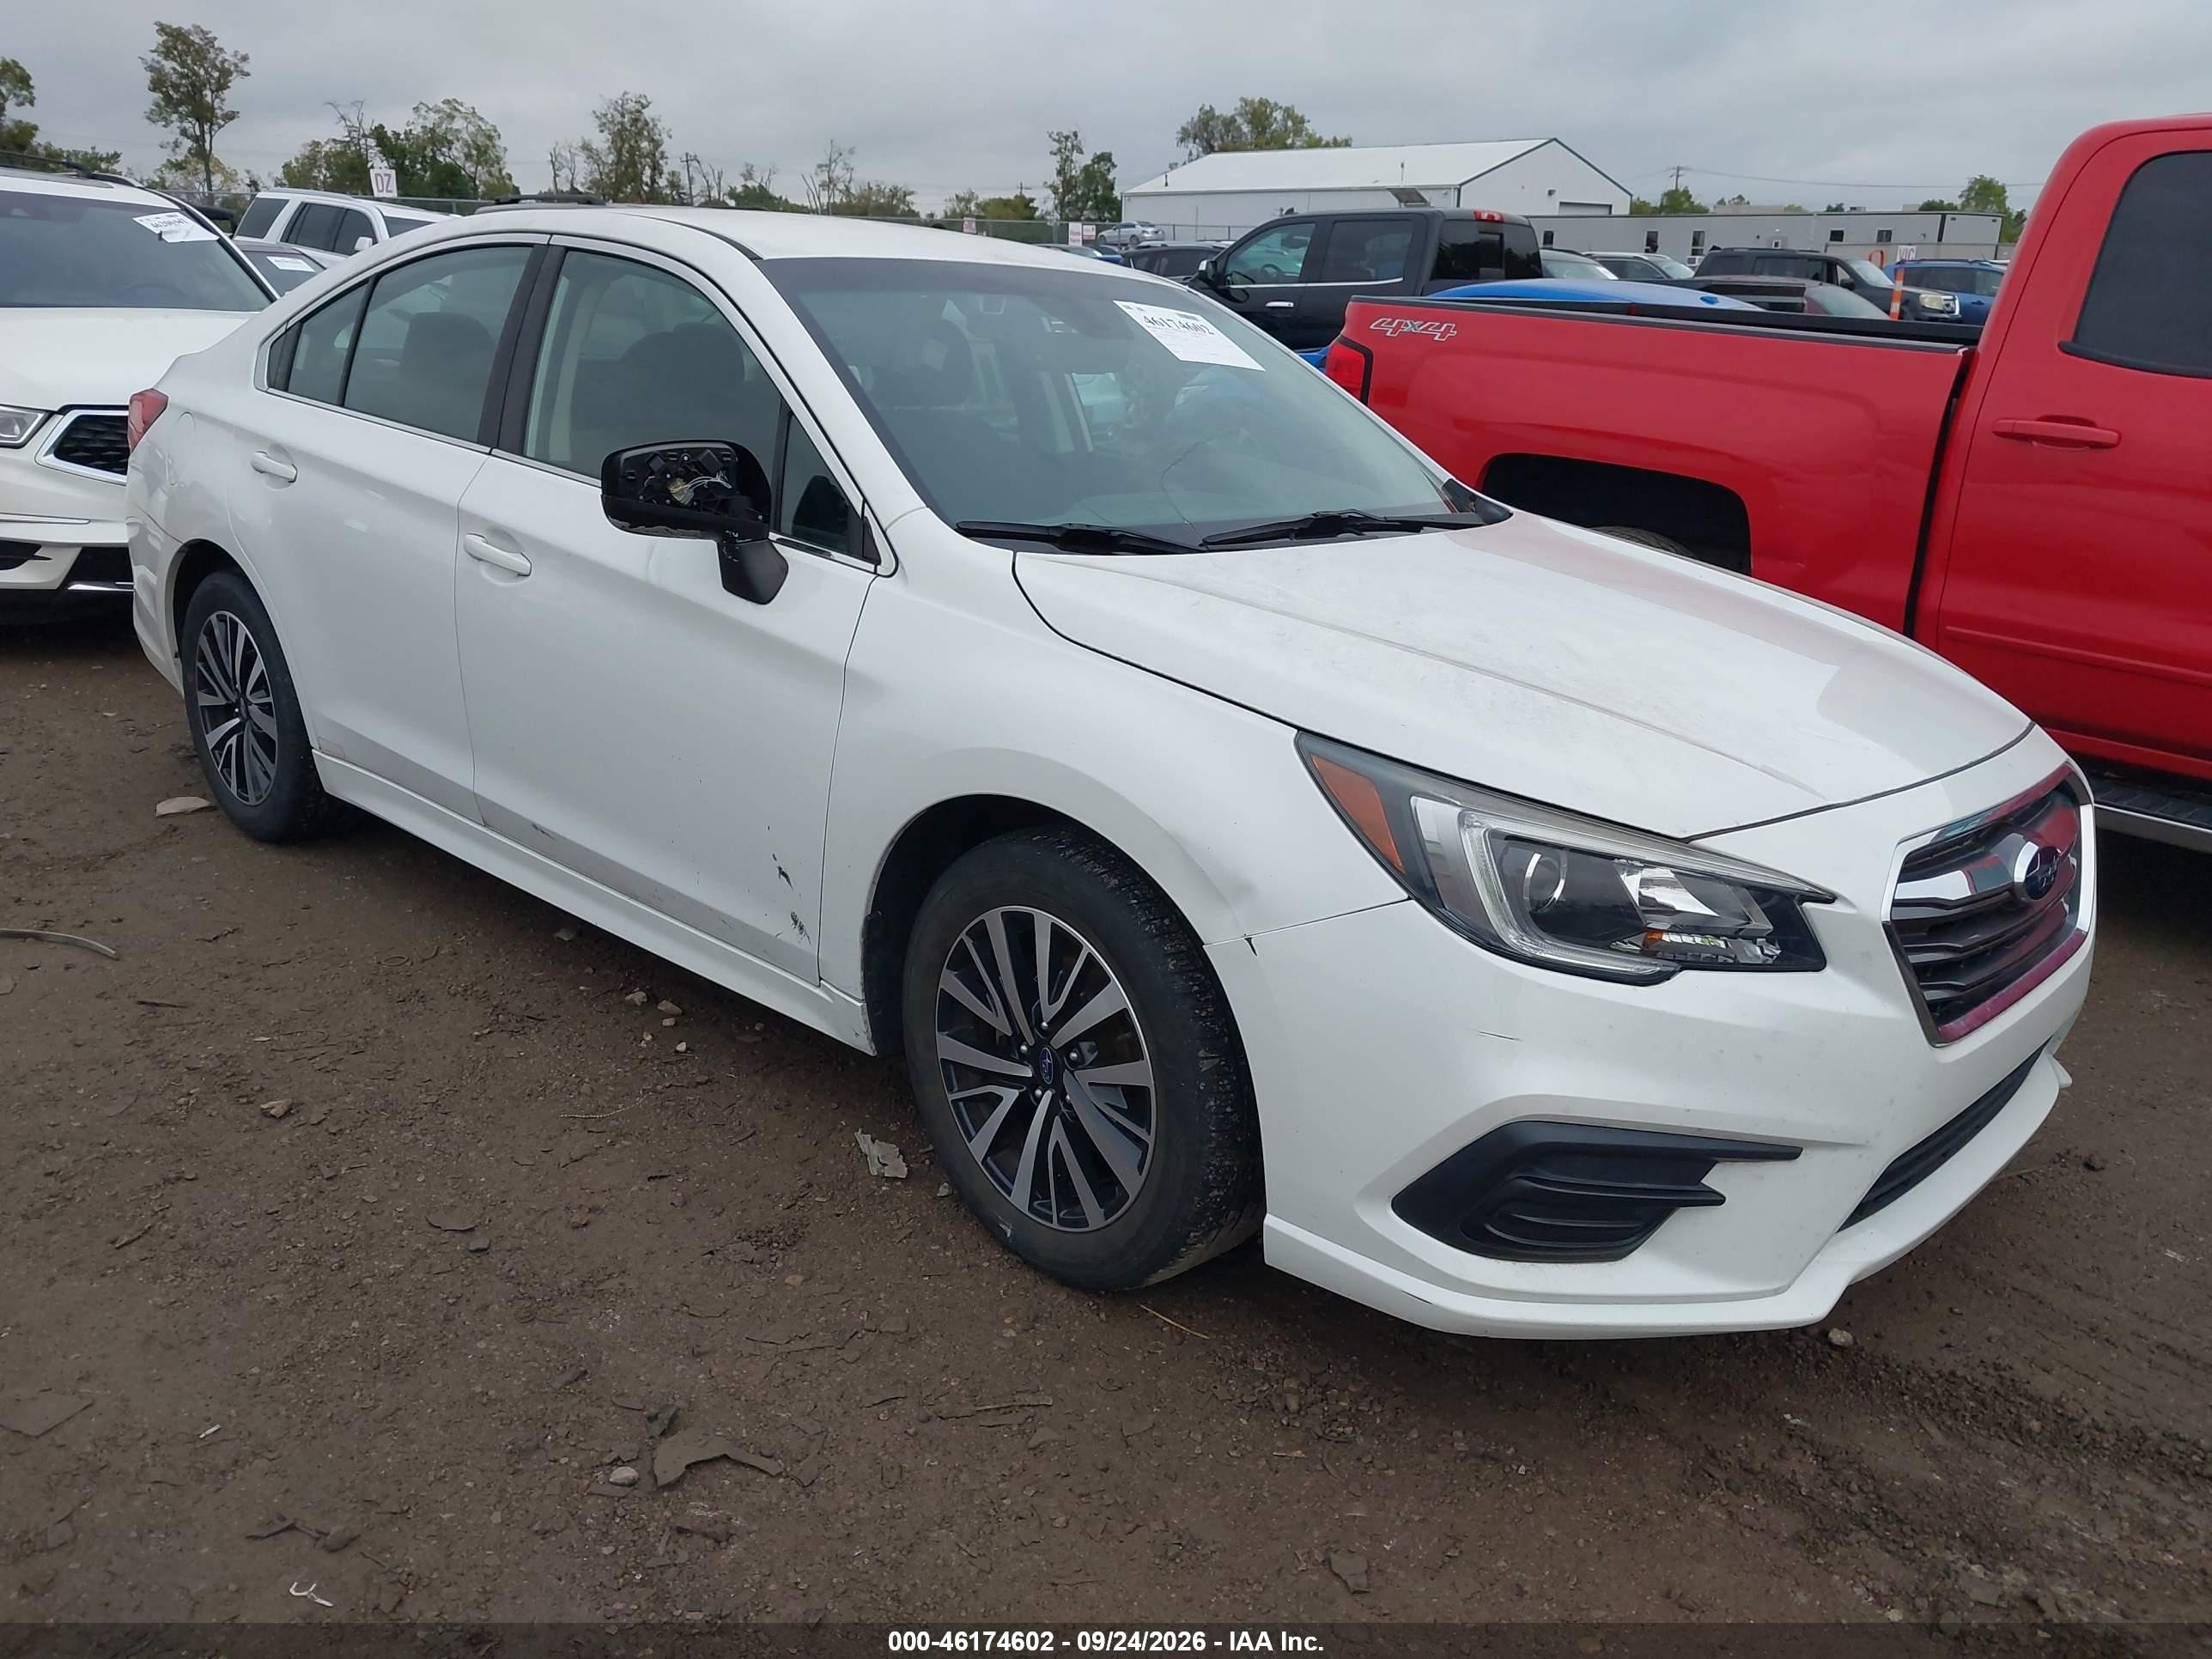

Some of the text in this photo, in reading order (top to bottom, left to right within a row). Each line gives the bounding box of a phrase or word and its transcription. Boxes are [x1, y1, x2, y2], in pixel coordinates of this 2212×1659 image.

[374, 173, 393, 193] DZ
[1143, 314, 1215, 336] 46174602
[1370, 318, 1457, 342] 4x4
